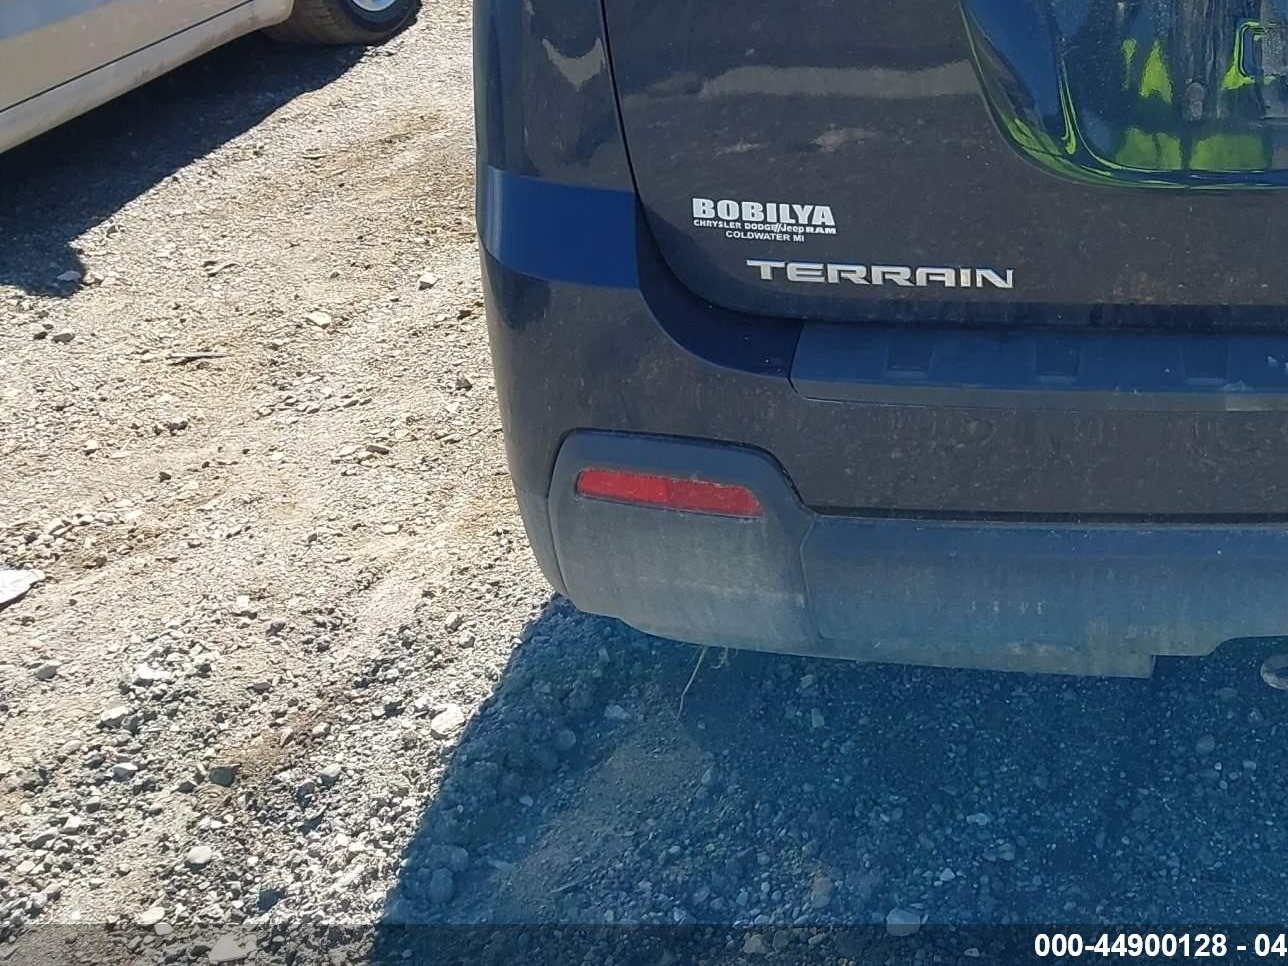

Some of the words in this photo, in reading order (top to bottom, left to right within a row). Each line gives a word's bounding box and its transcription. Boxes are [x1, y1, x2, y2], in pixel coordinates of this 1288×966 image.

[692, 197, 836, 226] BOBILYA
[693, 219, 742, 230] CHRYSLER
[805, 227, 837, 235] RAM
[725, 230, 791, 242] COLDWATER
[792, 234, 805, 243] MI
[746, 259, 1014, 289] TERRAIN
